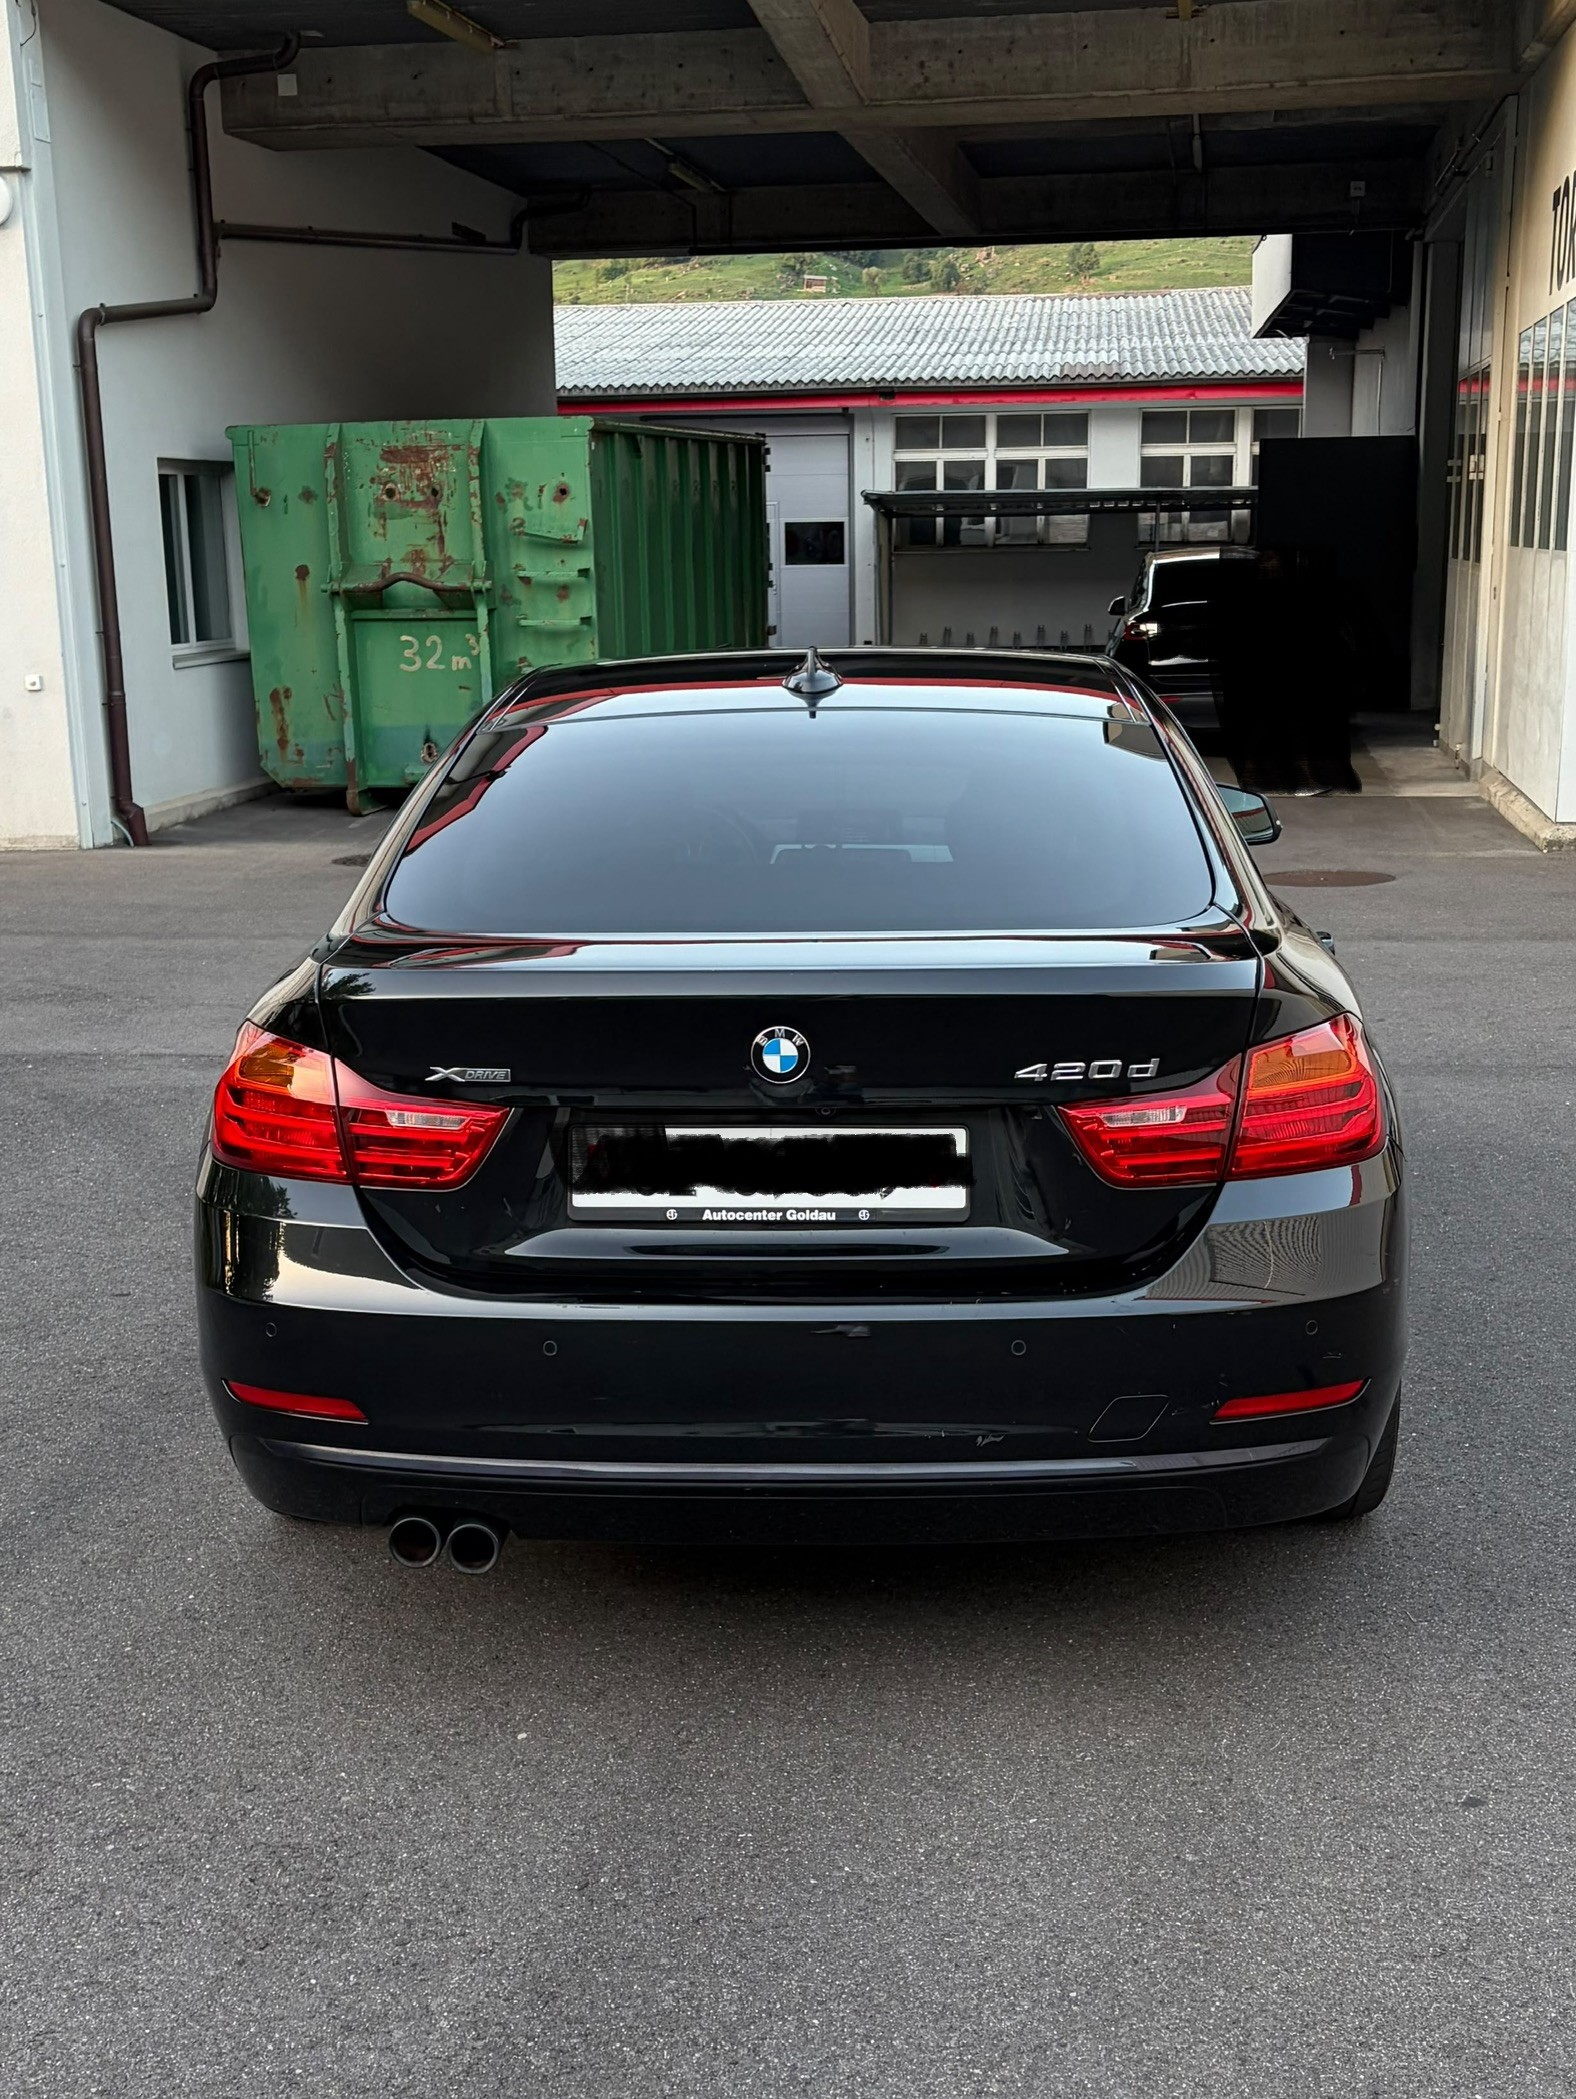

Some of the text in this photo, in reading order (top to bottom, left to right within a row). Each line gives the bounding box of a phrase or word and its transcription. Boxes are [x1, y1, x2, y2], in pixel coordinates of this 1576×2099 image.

[400, 635, 445, 672] 32
[756, 1028, 806, 1047] BMW
[1014, 1058, 1160, 1082] 420d
[702, 1209, 836, 1221] Autocenter Goldau
